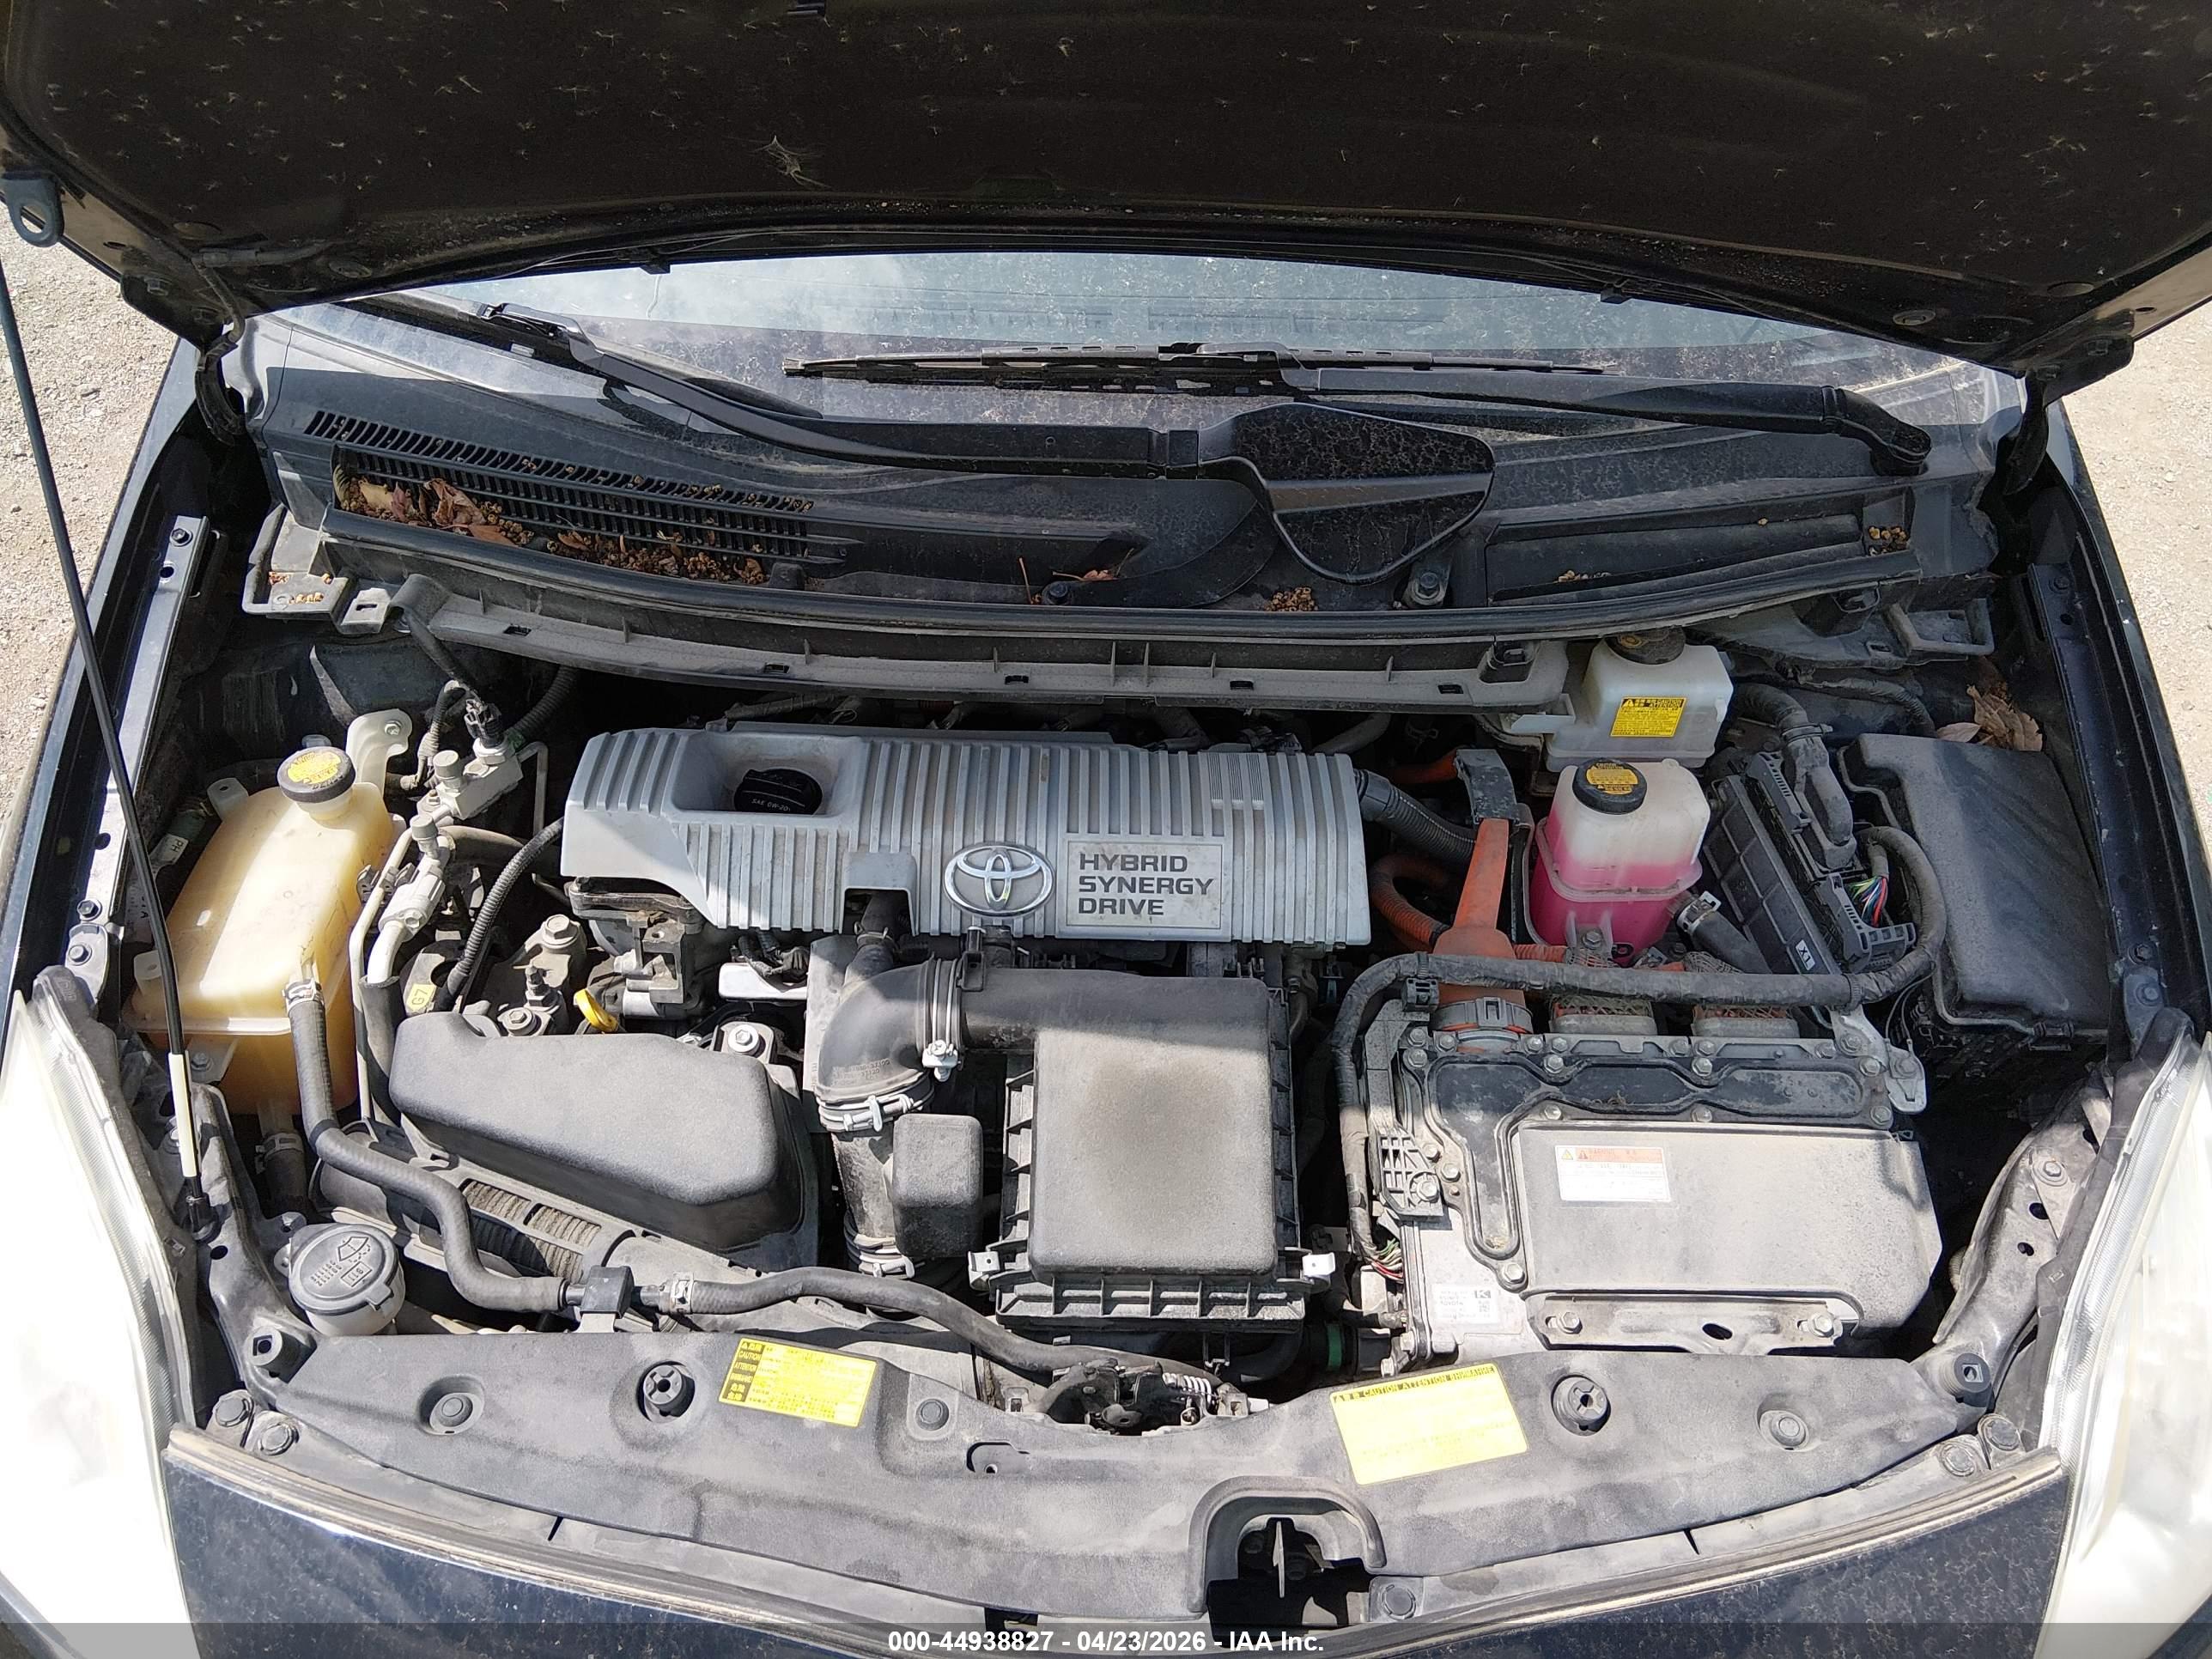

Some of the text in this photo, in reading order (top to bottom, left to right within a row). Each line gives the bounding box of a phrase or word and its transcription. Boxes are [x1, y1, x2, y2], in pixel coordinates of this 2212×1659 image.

[1079, 853, 1188, 872] HYBRID
[1079, 876, 1214, 895] SYNERGY
[1079, 897, 1164, 915] DRIVE
[411, 988, 428, 1006] G7
[738, 1350, 763, 1361] CAUTION
[1364, 1383, 1399, 1397] CAUTION
[1403, 1376, 1446, 1389] ATTENTION
